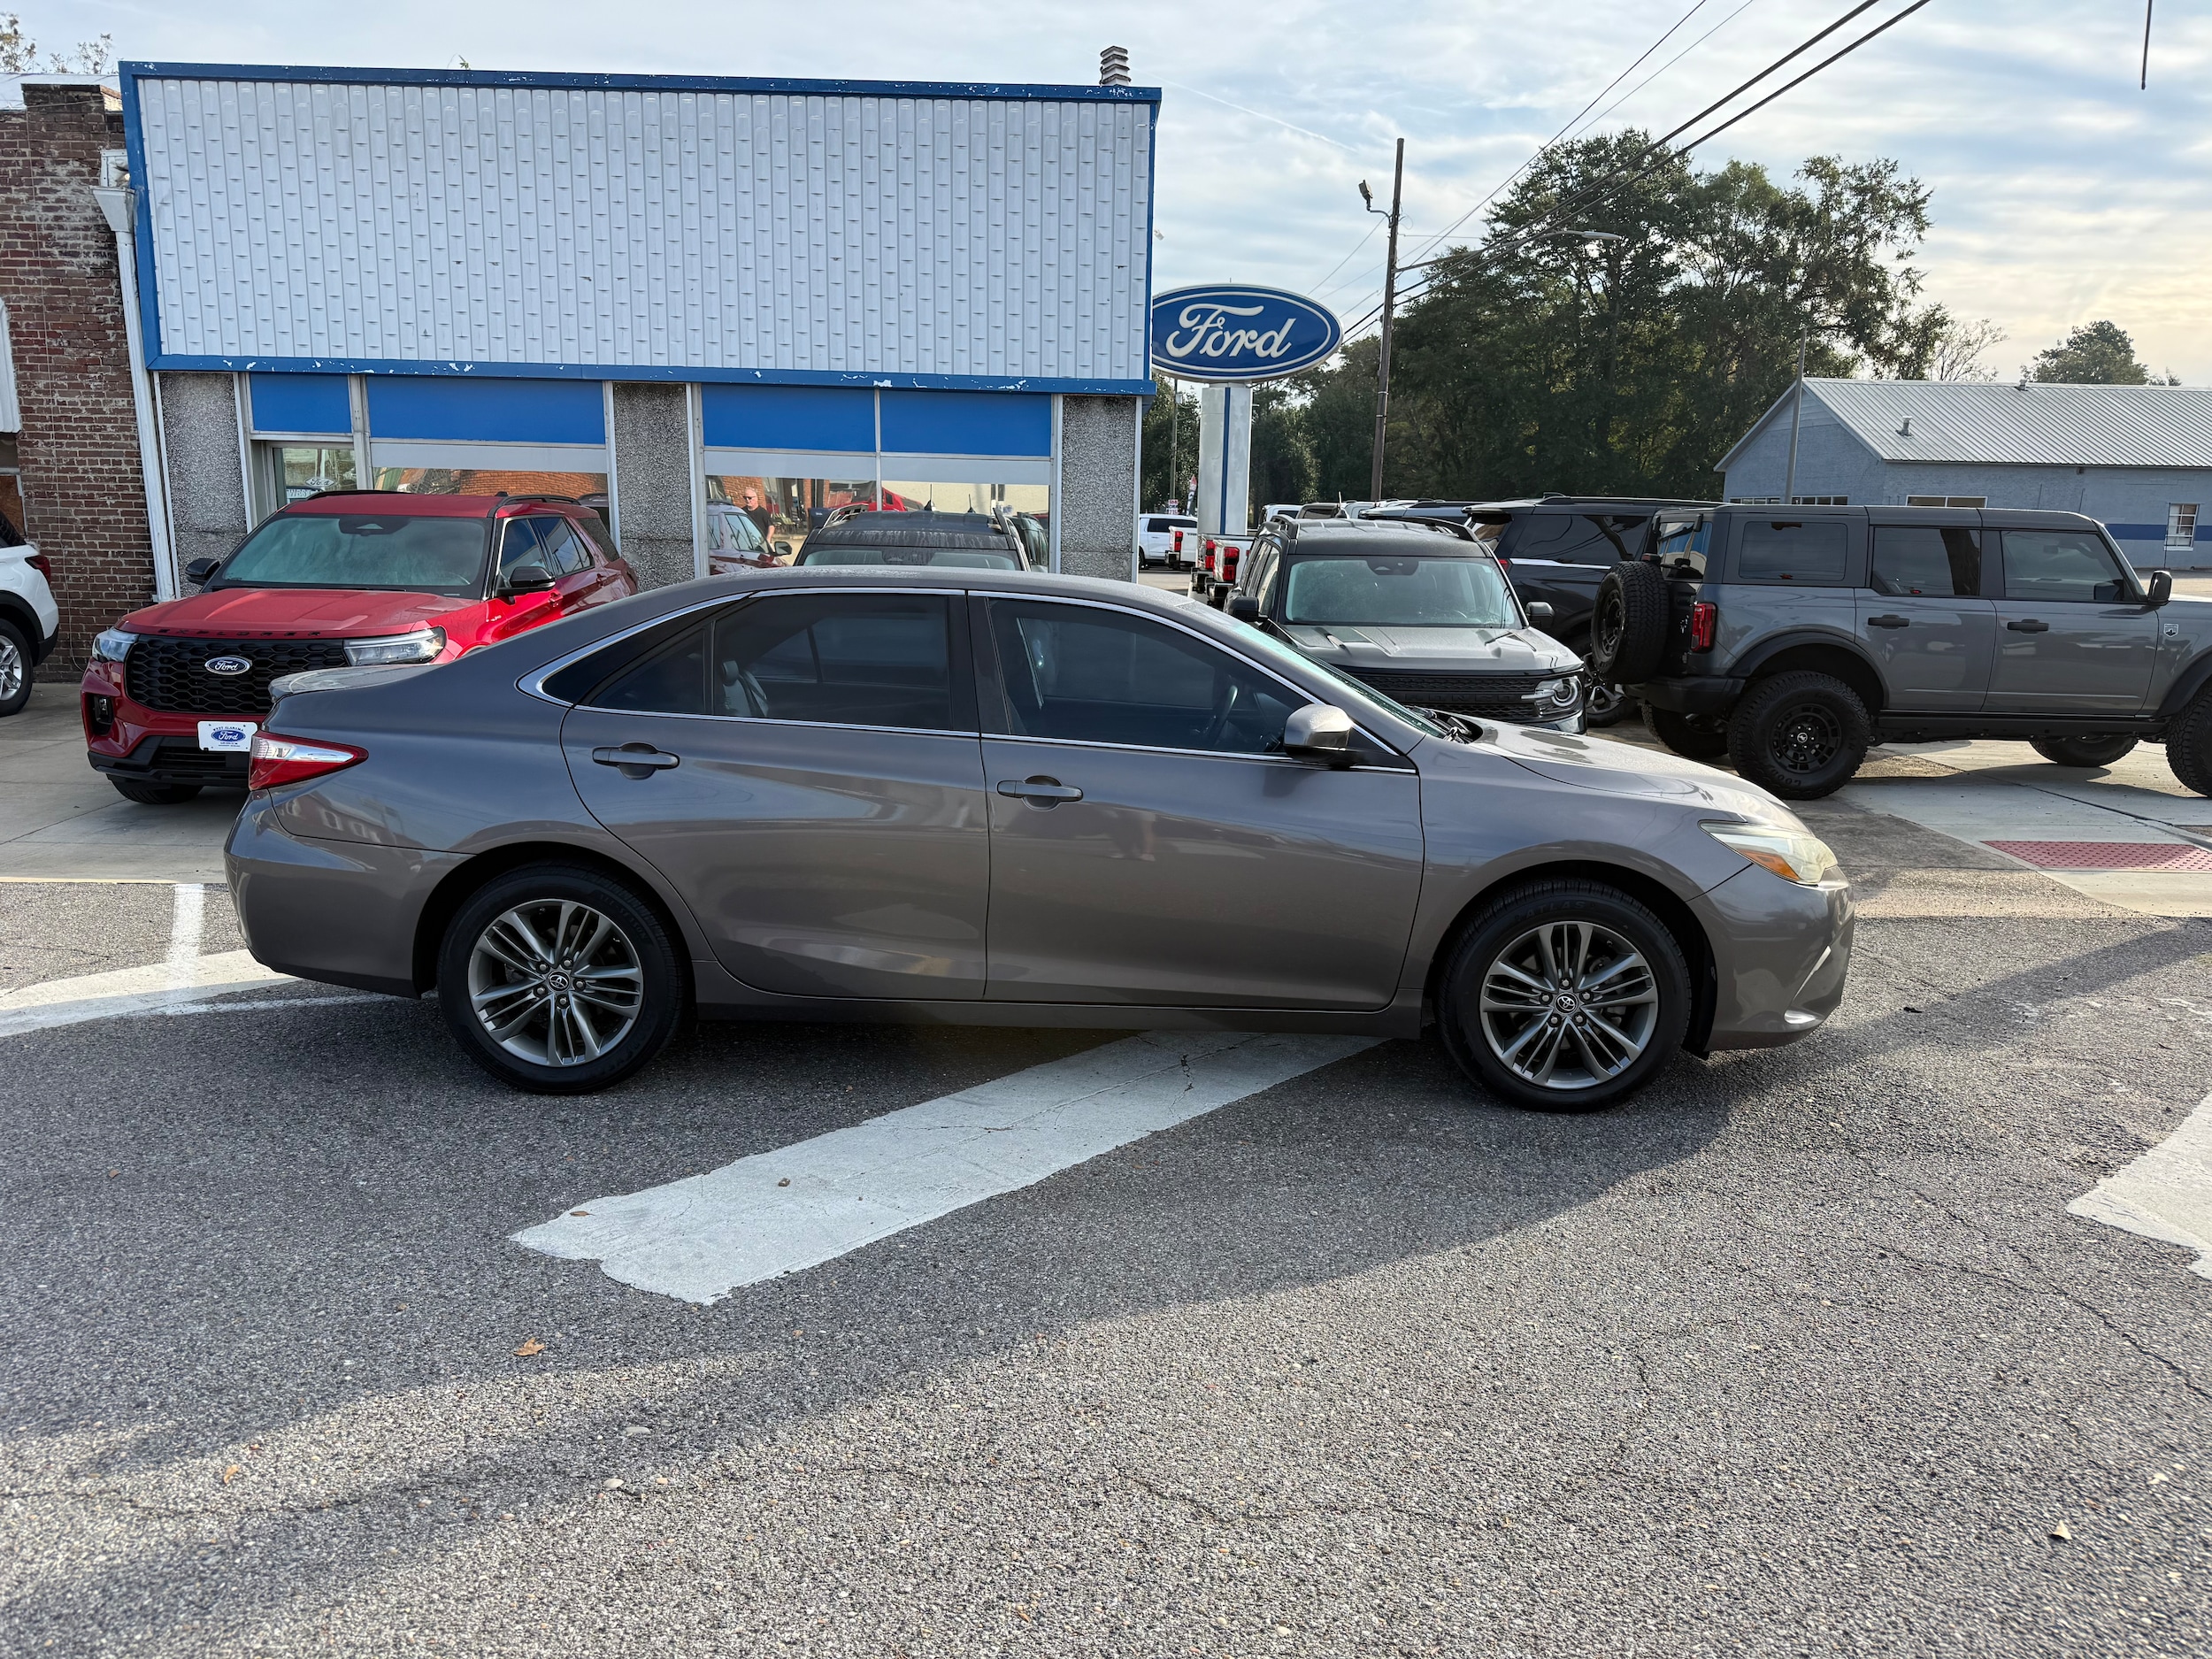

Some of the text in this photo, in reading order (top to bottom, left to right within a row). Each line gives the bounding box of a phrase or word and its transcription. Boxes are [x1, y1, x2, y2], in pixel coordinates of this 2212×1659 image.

[1165, 303, 1296, 358] Ford
[157, 628, 321, 637] EXPLORER
[214, 660, 239, 672] Ford
[218, 731, 239, 741] Ford
